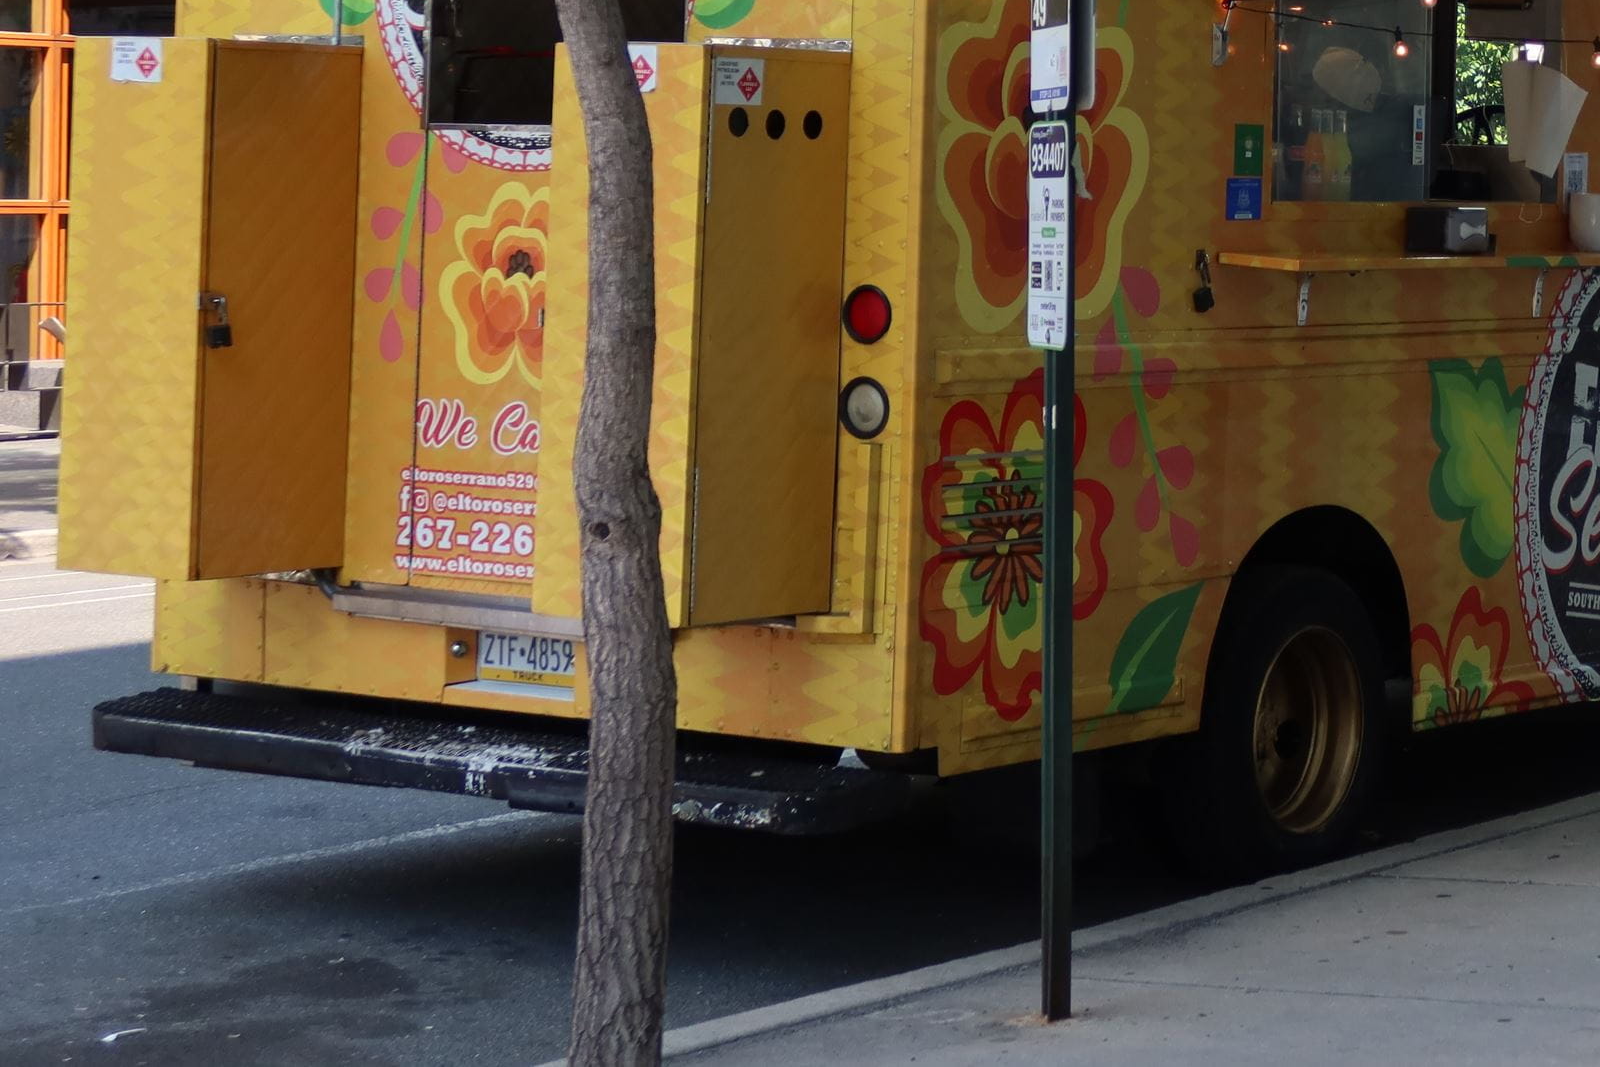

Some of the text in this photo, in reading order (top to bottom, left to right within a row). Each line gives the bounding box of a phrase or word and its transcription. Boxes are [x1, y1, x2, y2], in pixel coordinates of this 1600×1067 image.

[1031, 141, 1065, 172] 934407
[416, 398, 477, 450] We
[512, 669, 544, 682] TRUCK
